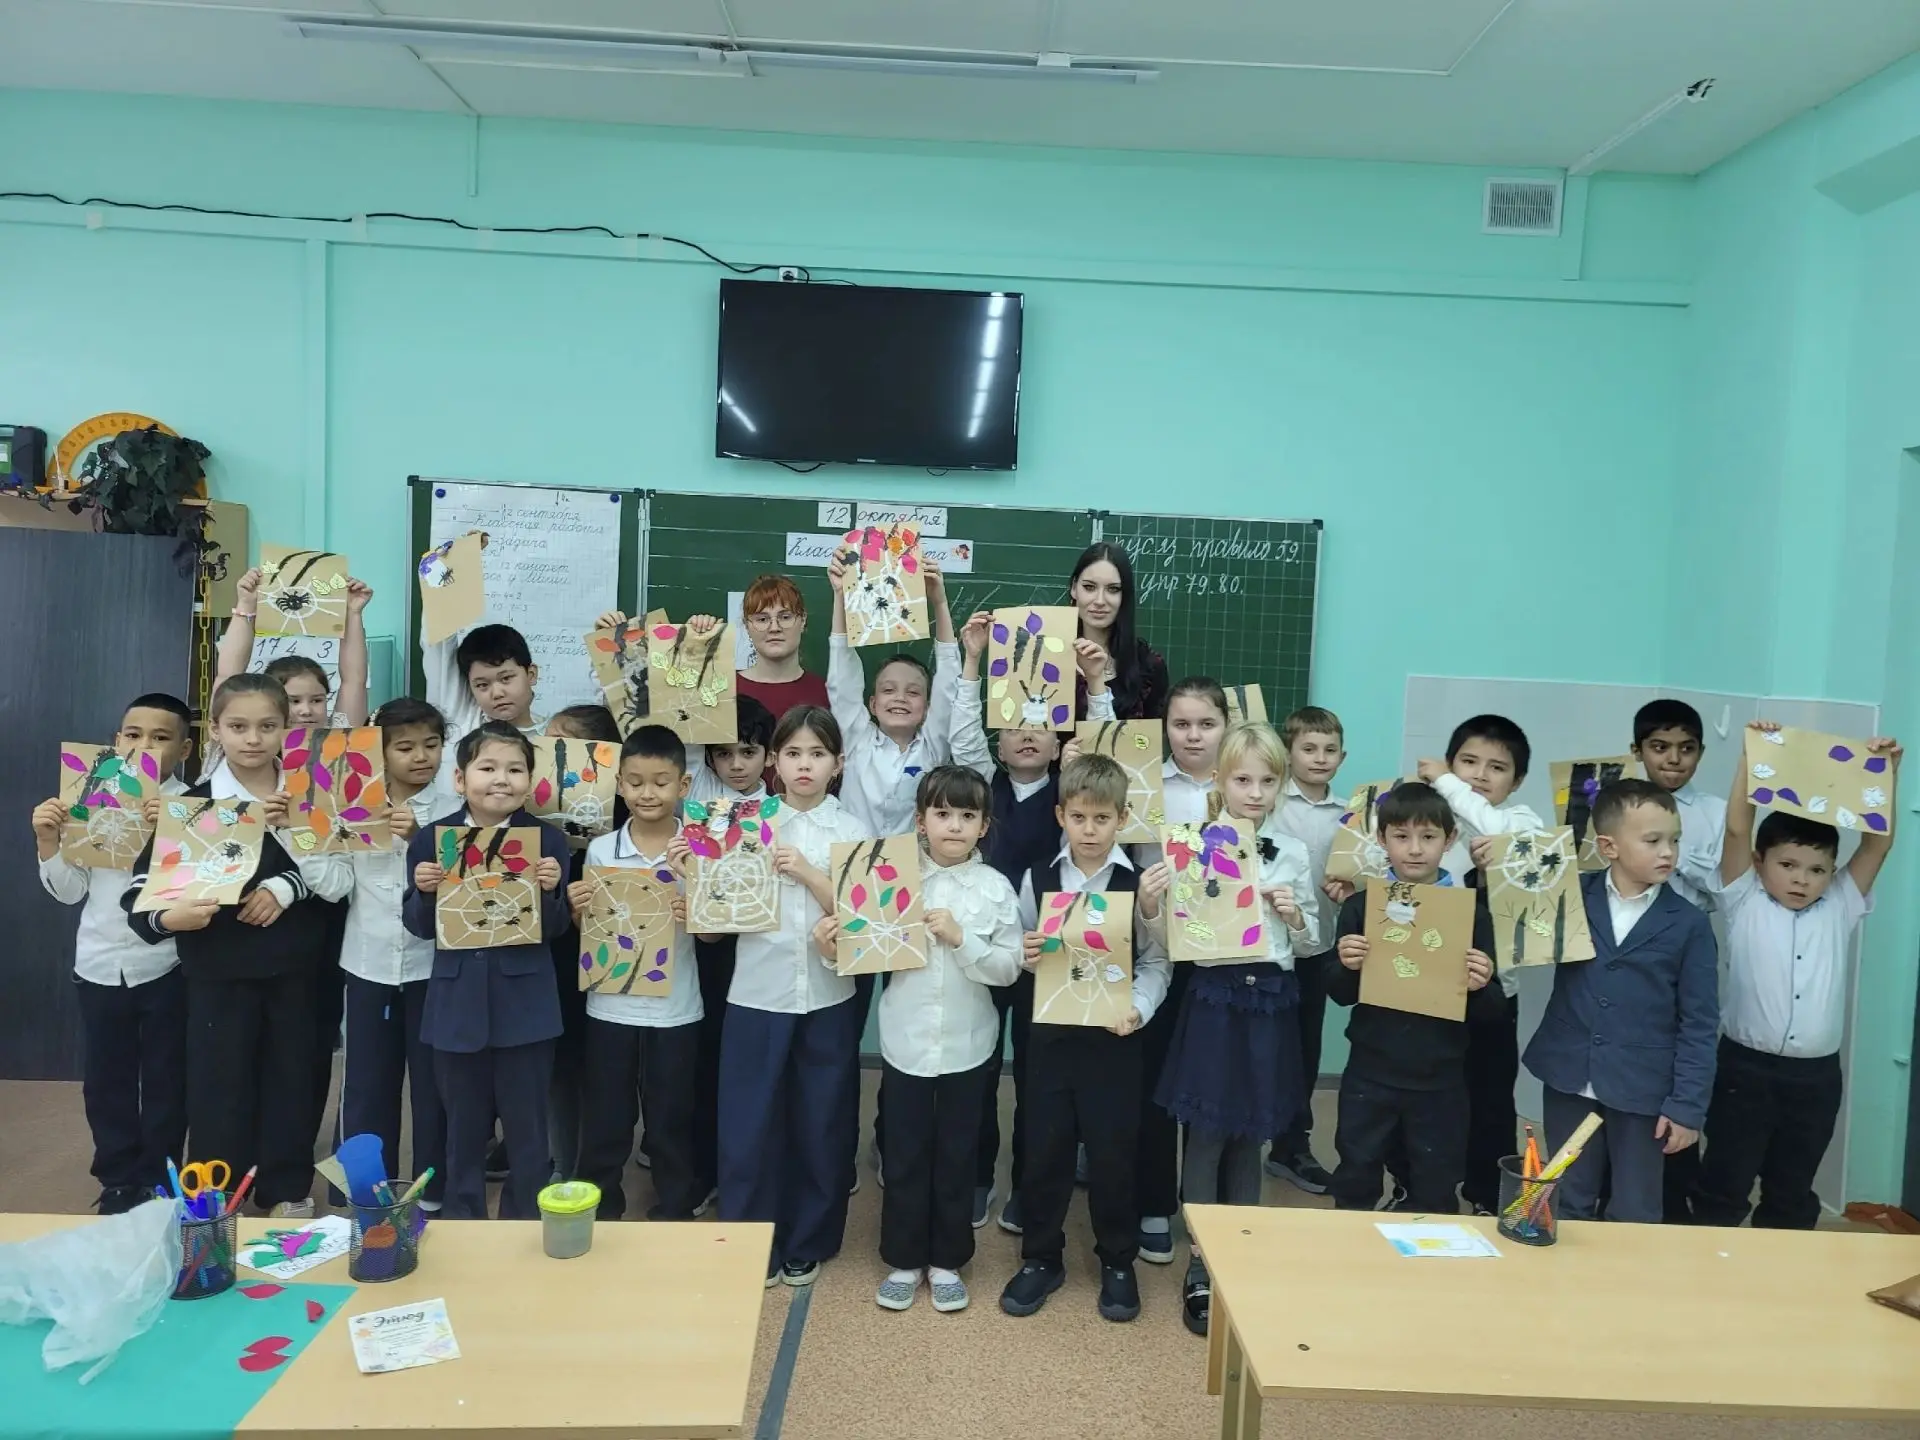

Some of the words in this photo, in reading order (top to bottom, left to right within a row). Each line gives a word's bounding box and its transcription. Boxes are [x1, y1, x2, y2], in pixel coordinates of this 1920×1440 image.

[826, 506, 848, 524] 12
[788, 537, 834, 557] Клас
[1189, 527, 1271, 568] правило
[1139, 573, 1178, 604] упр
[316, 641, 333, 659] 3
